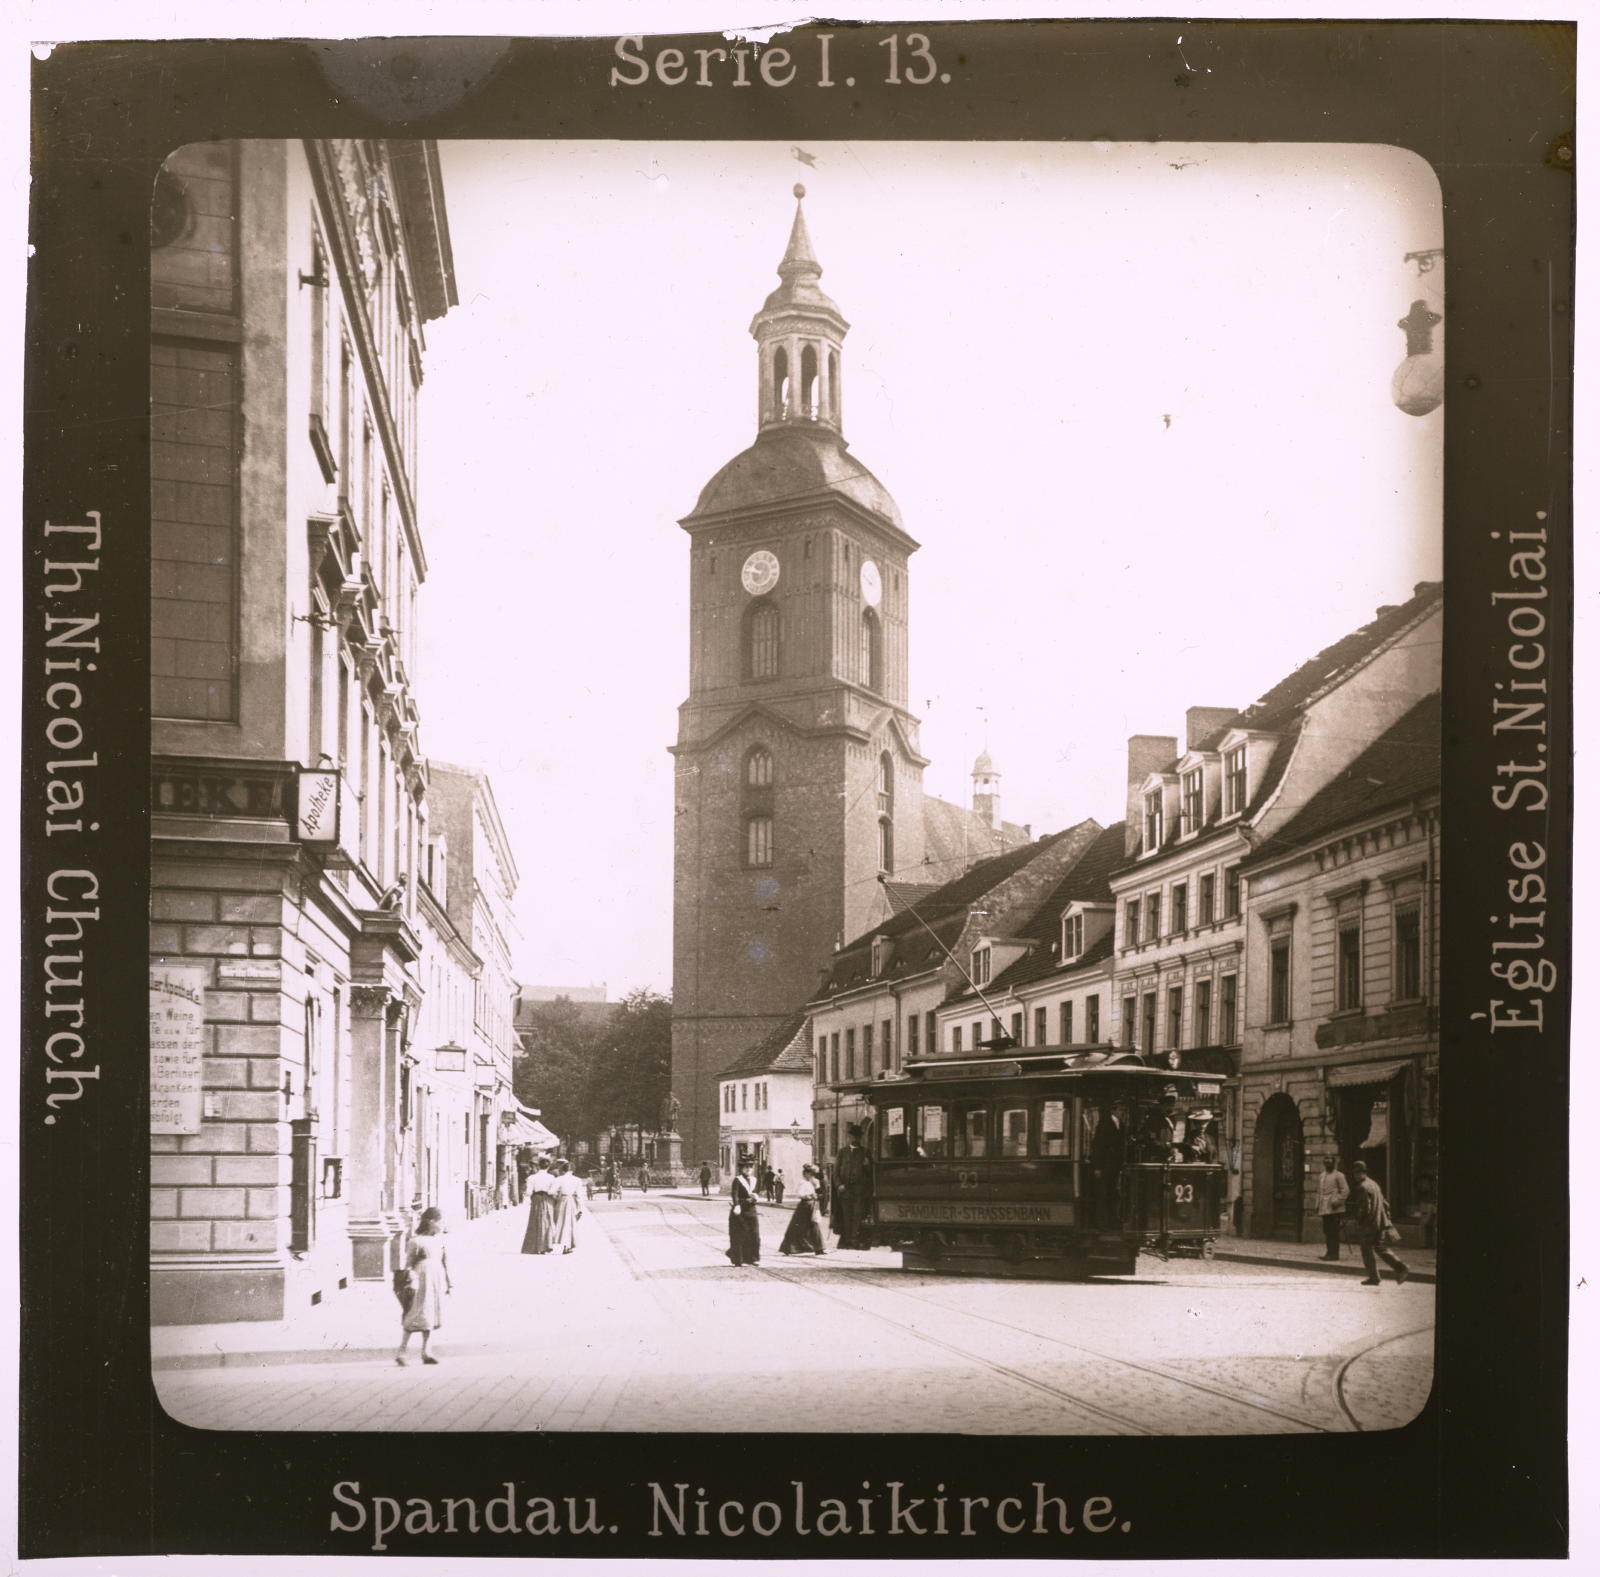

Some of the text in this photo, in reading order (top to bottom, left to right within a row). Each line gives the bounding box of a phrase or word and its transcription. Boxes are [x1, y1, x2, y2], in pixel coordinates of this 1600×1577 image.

[299, 776, 334, 837] Apotheke
[958, 1170, 979, 1190] 23
[1174, 1183, 1195, 1204] 23
